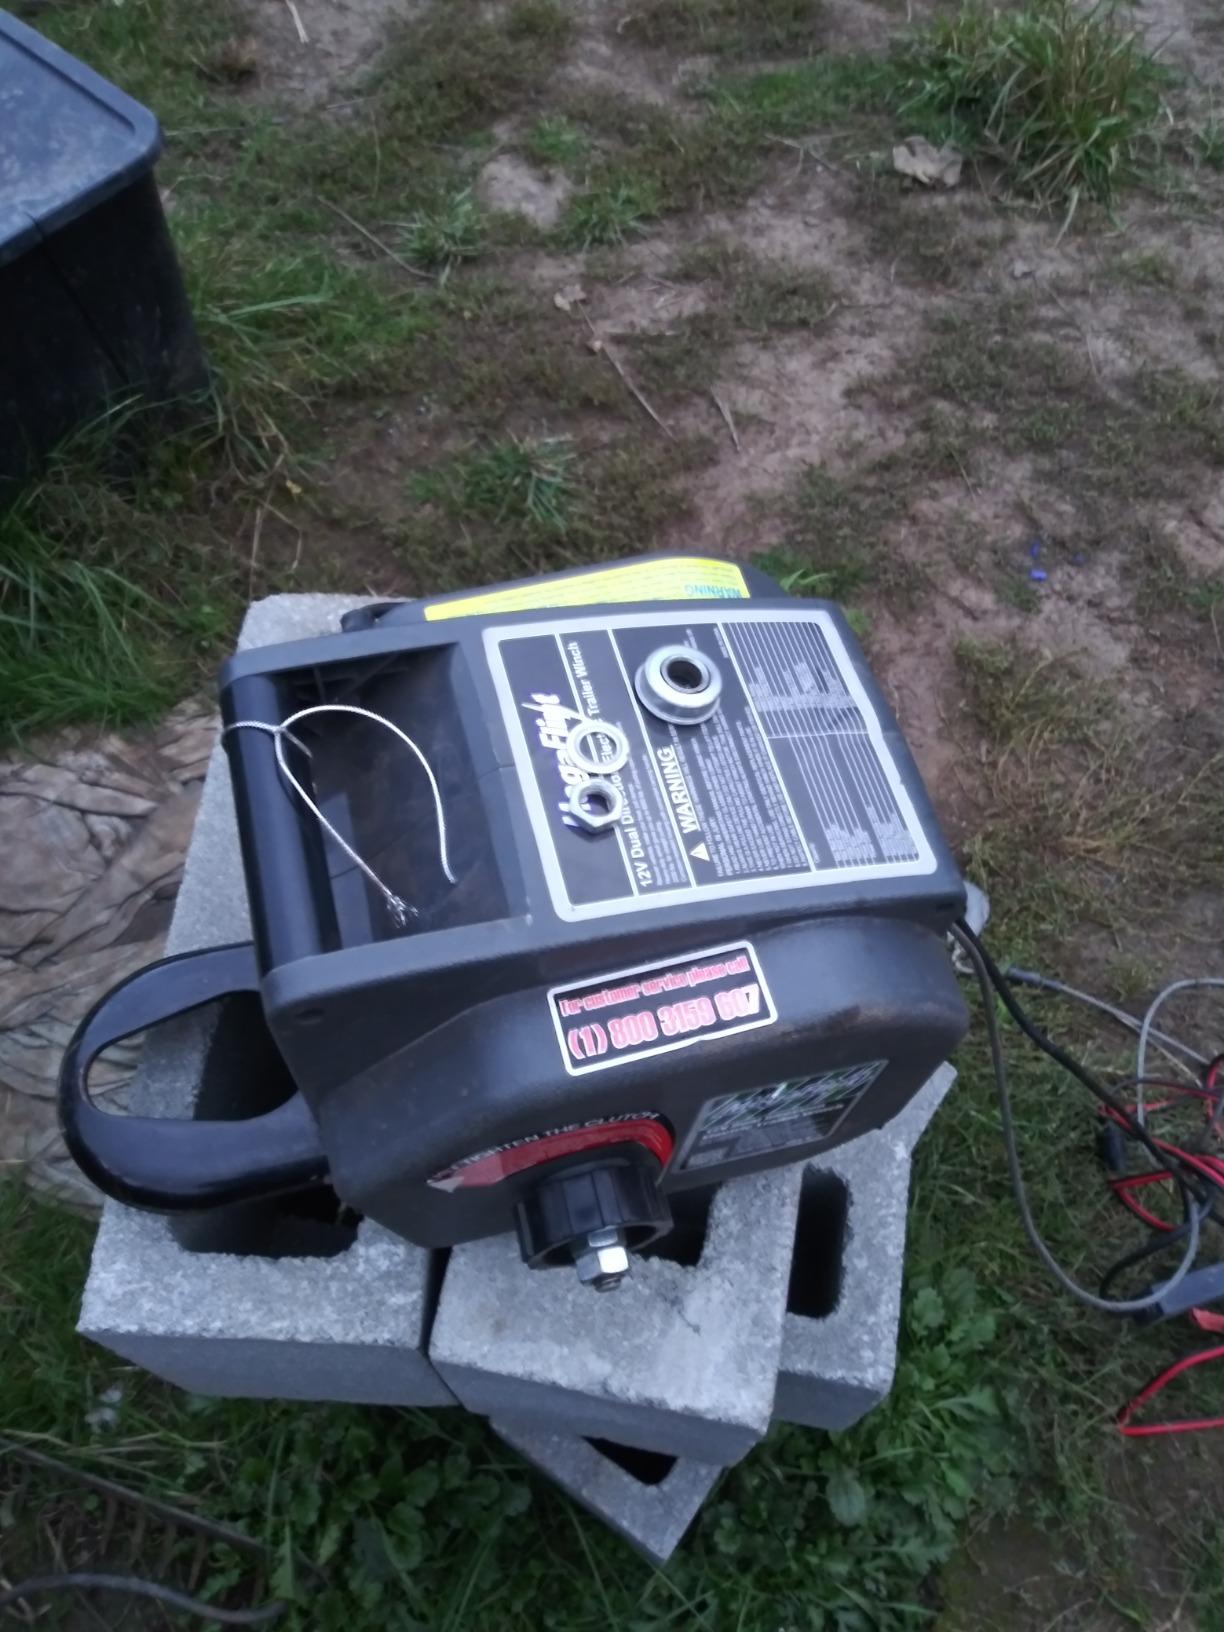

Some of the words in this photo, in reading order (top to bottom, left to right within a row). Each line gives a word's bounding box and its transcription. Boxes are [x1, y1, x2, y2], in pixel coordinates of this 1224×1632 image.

[567, 641, 587, 679] Winch
[582, 680, 600, 718] Trailer
[657, 745, 699, 834] WARNING
[624, 831, 643, 860] Dual
[633, 859, 653, 888] 12V
[559, 998, 583, 1017] For
[583, 983, 641, 1011] customer
[641, 973, 688, 996] service
[687, 964, 727, 987] please
[725, 955, 750, 975] call
[567, 1023, 607, 1059] (1)
[607, 1011, 658, 1049] 800
[657, 997, 717, 1036] 3159
[714, 984, 760, 1021] 607
[543, 1122, 580, 1138] THE
